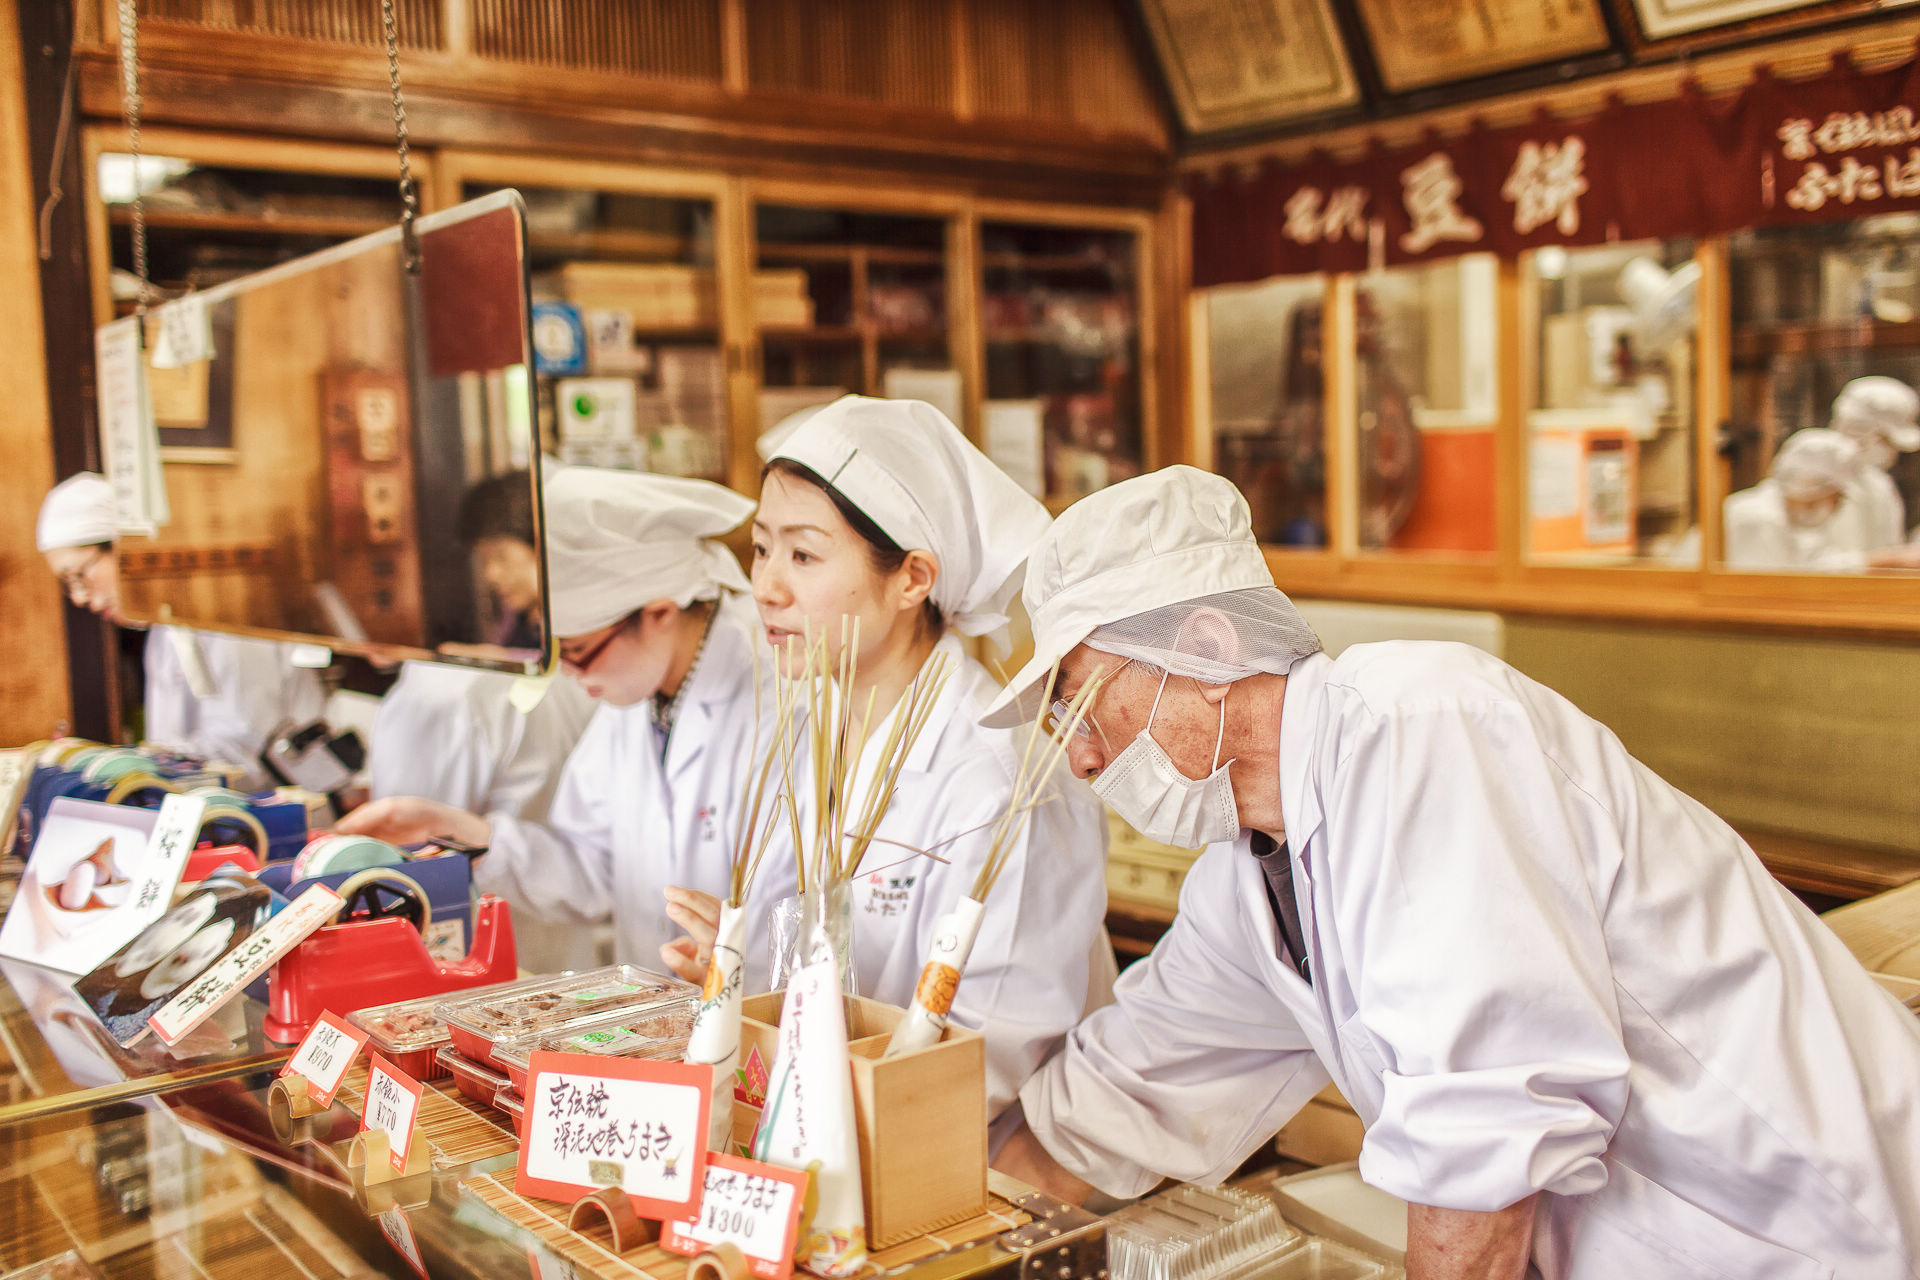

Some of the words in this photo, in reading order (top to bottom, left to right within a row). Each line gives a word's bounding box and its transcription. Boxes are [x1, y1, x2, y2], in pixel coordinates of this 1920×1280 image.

[548, 1076, 610, 1119] 京伝統
[553, 1119, 673, 1160] 深泥池巻ちまき
[707, 1205, 756, 1239] ¥300
